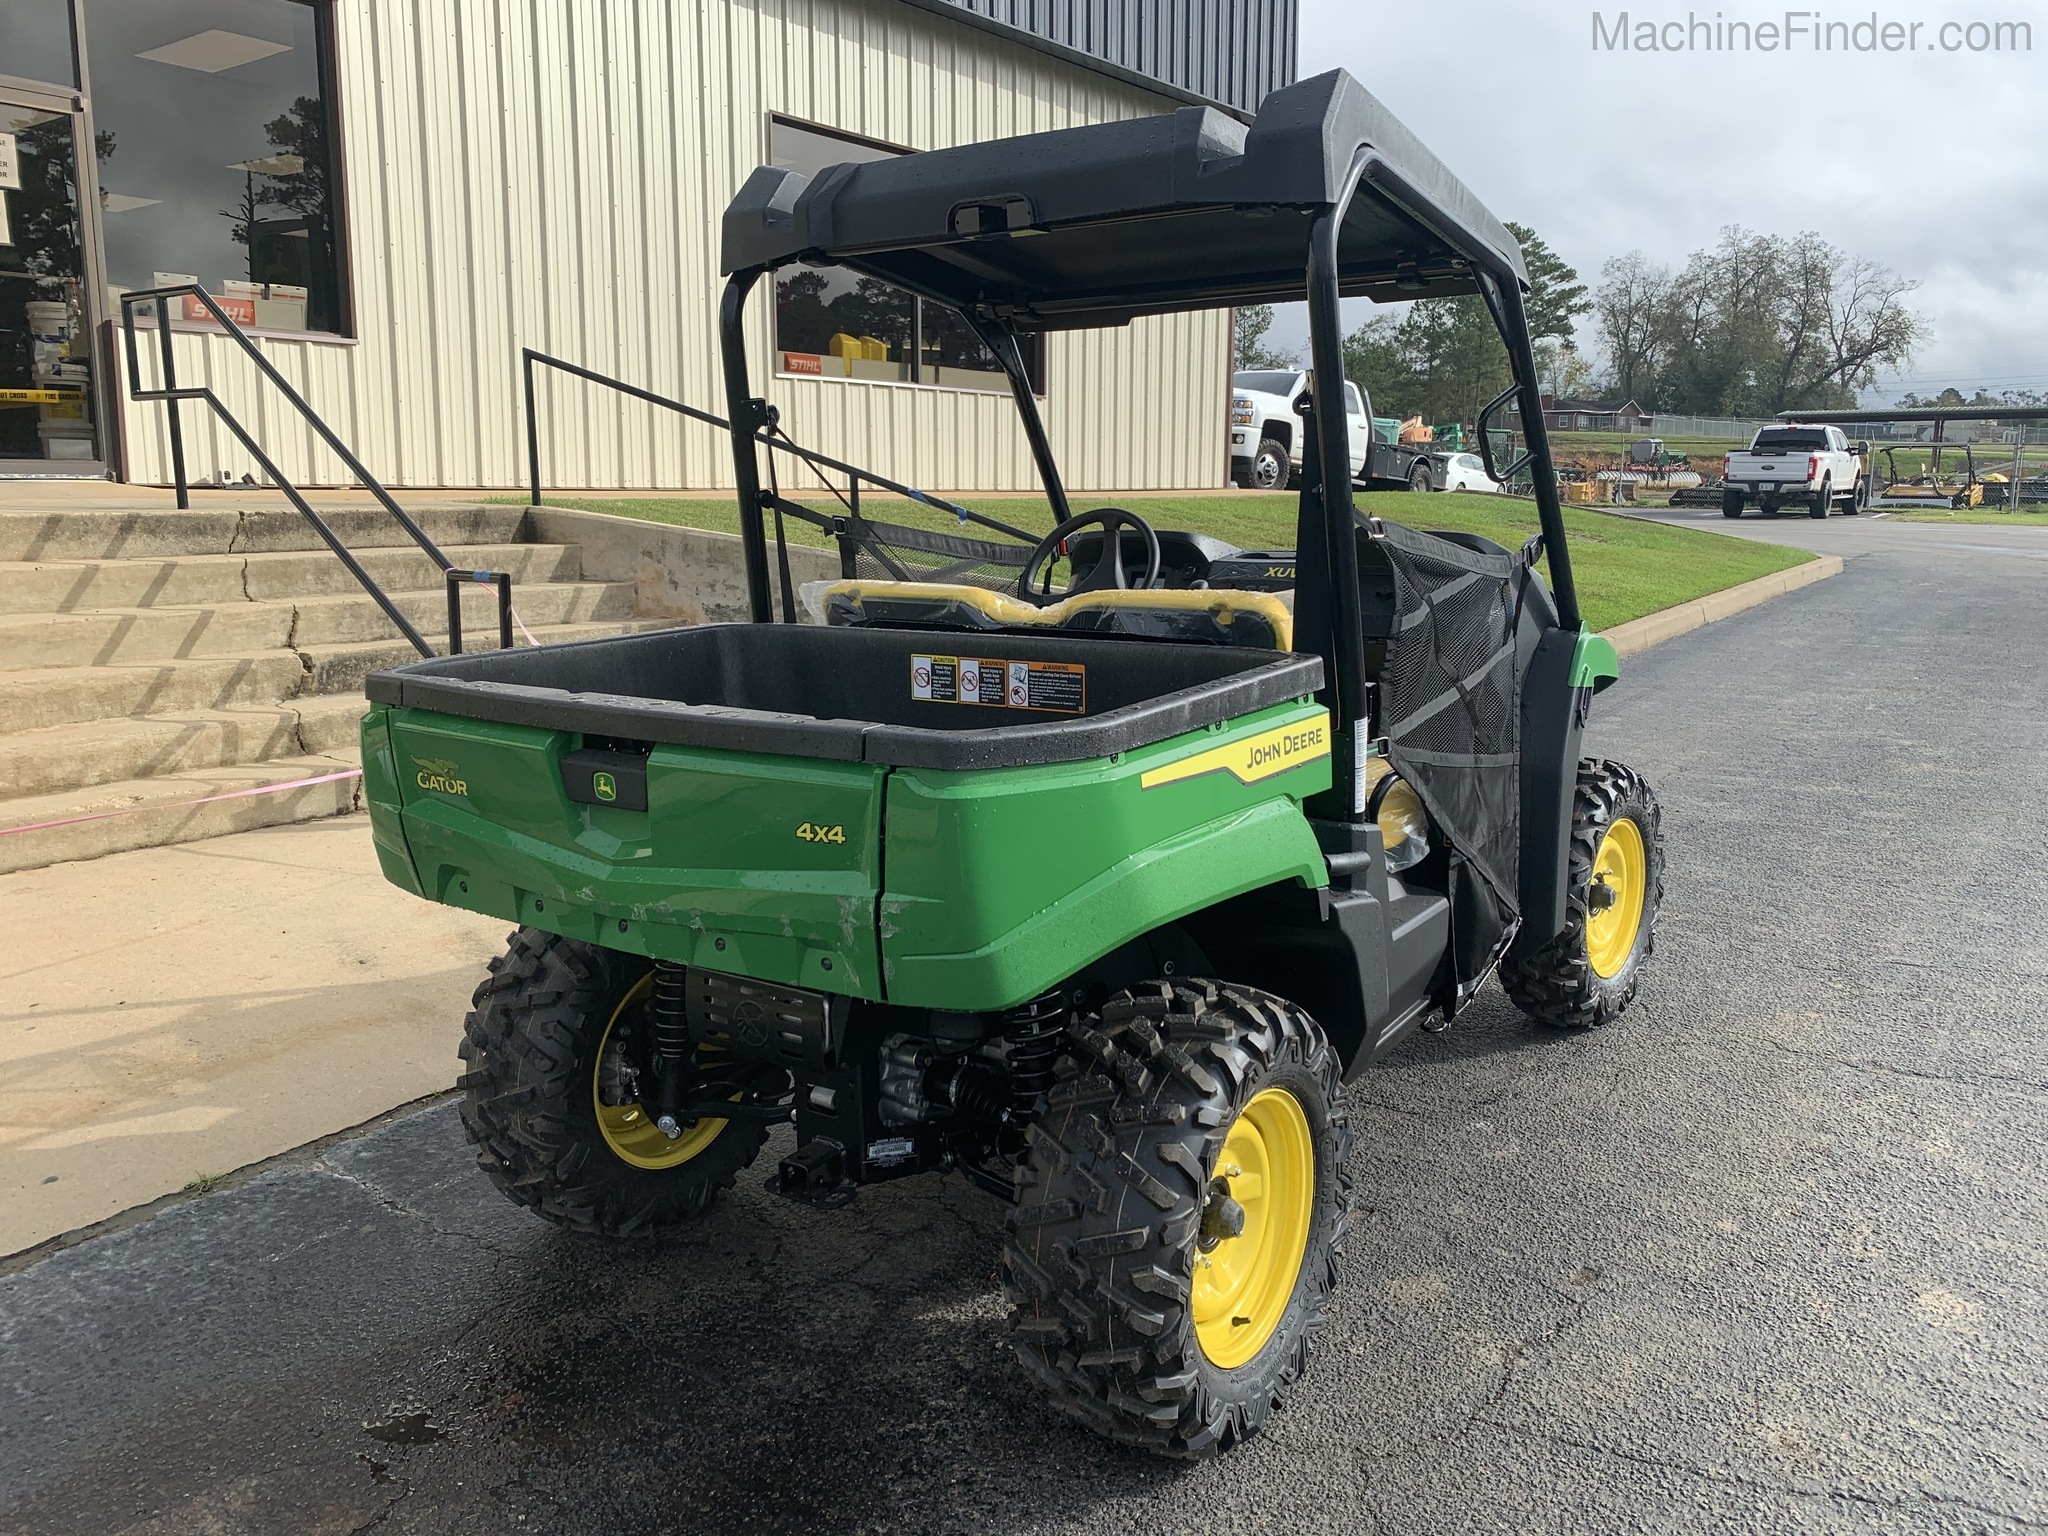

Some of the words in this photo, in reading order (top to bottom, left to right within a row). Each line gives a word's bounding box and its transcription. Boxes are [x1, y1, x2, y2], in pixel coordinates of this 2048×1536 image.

[192, 303, 250, 322] SHL
[790, 359, 820, 371] STIHL
[1247, 741, 1281, 769] JOHN
[1283, 727, 1323, 755] DEERE
[416, 771, 469, 797] GATOR
